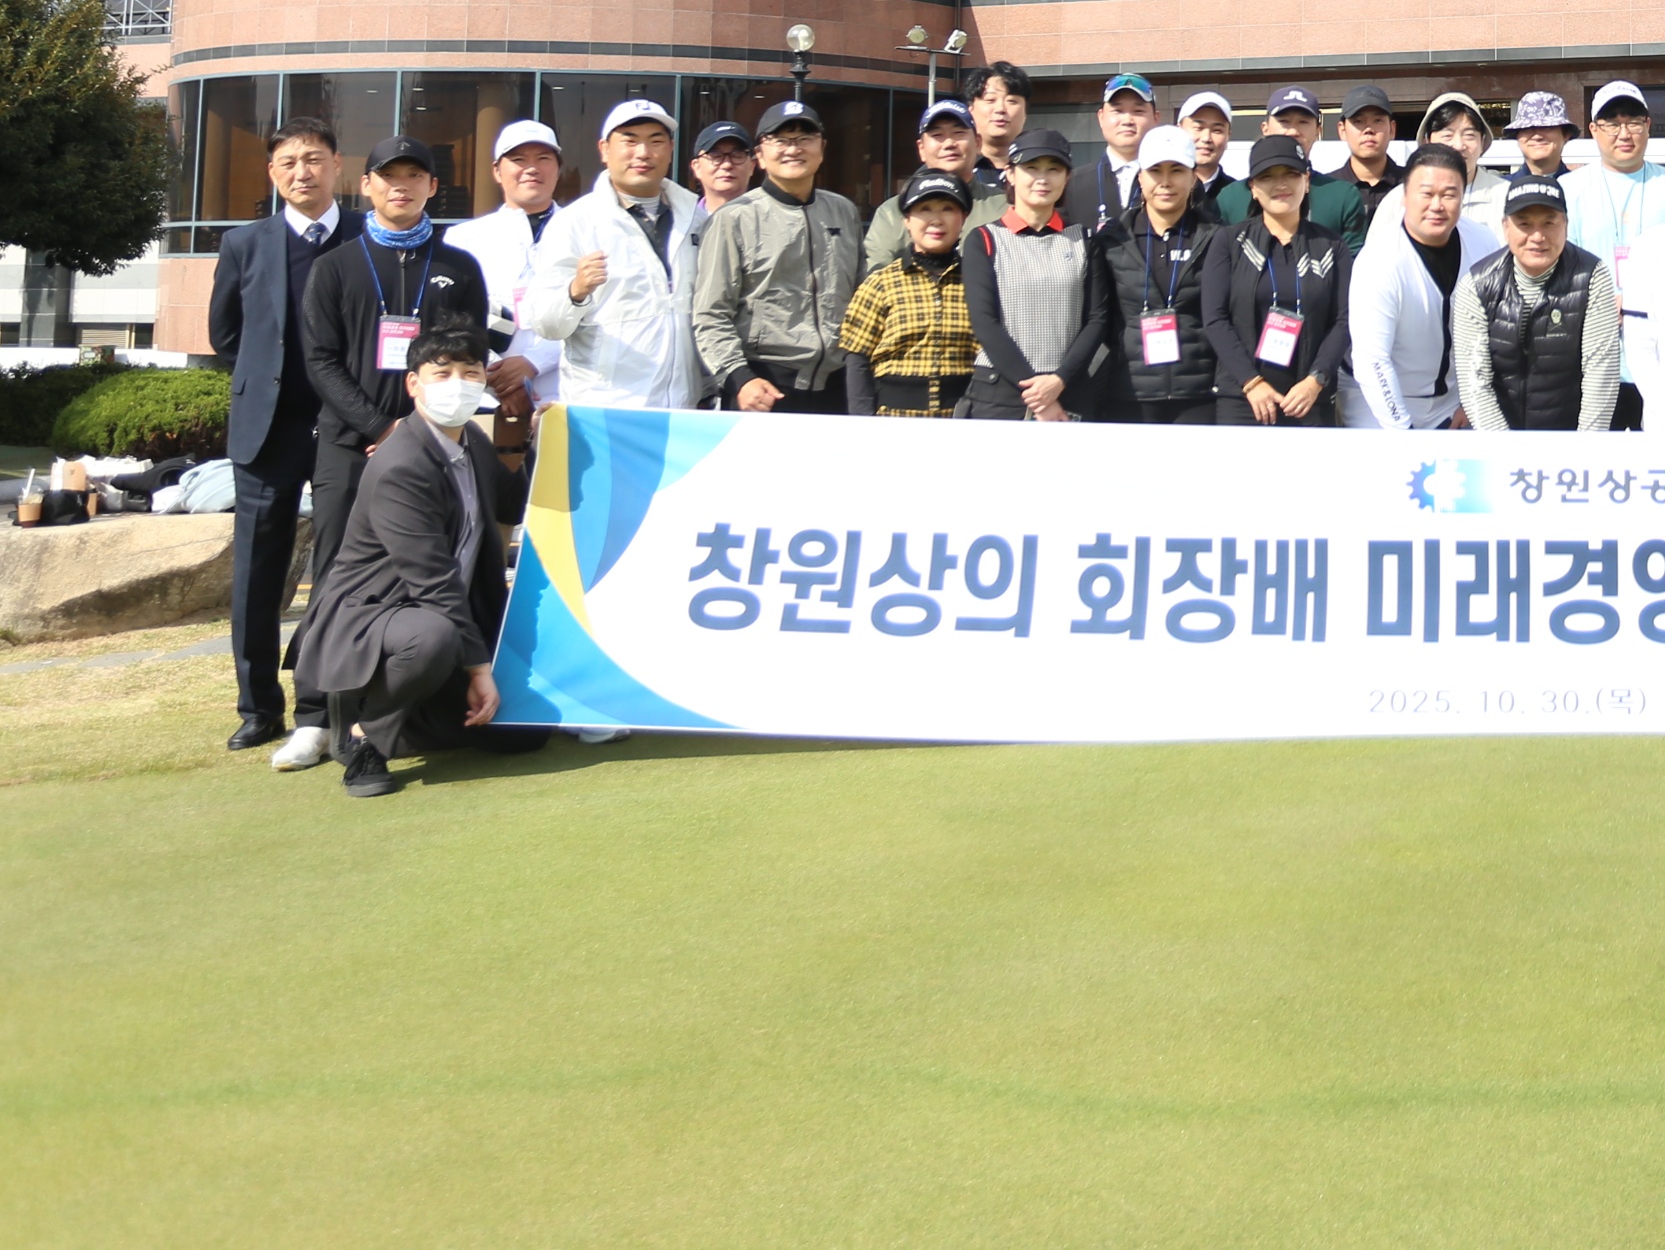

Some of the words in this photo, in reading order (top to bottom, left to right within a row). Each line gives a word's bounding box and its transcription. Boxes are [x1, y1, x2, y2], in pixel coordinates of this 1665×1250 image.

[687, 522, 1038, 638] 창원상의
[1069, 533, 1329, 643] 회장배
[1368, 690, 1461, 713] 2025.
